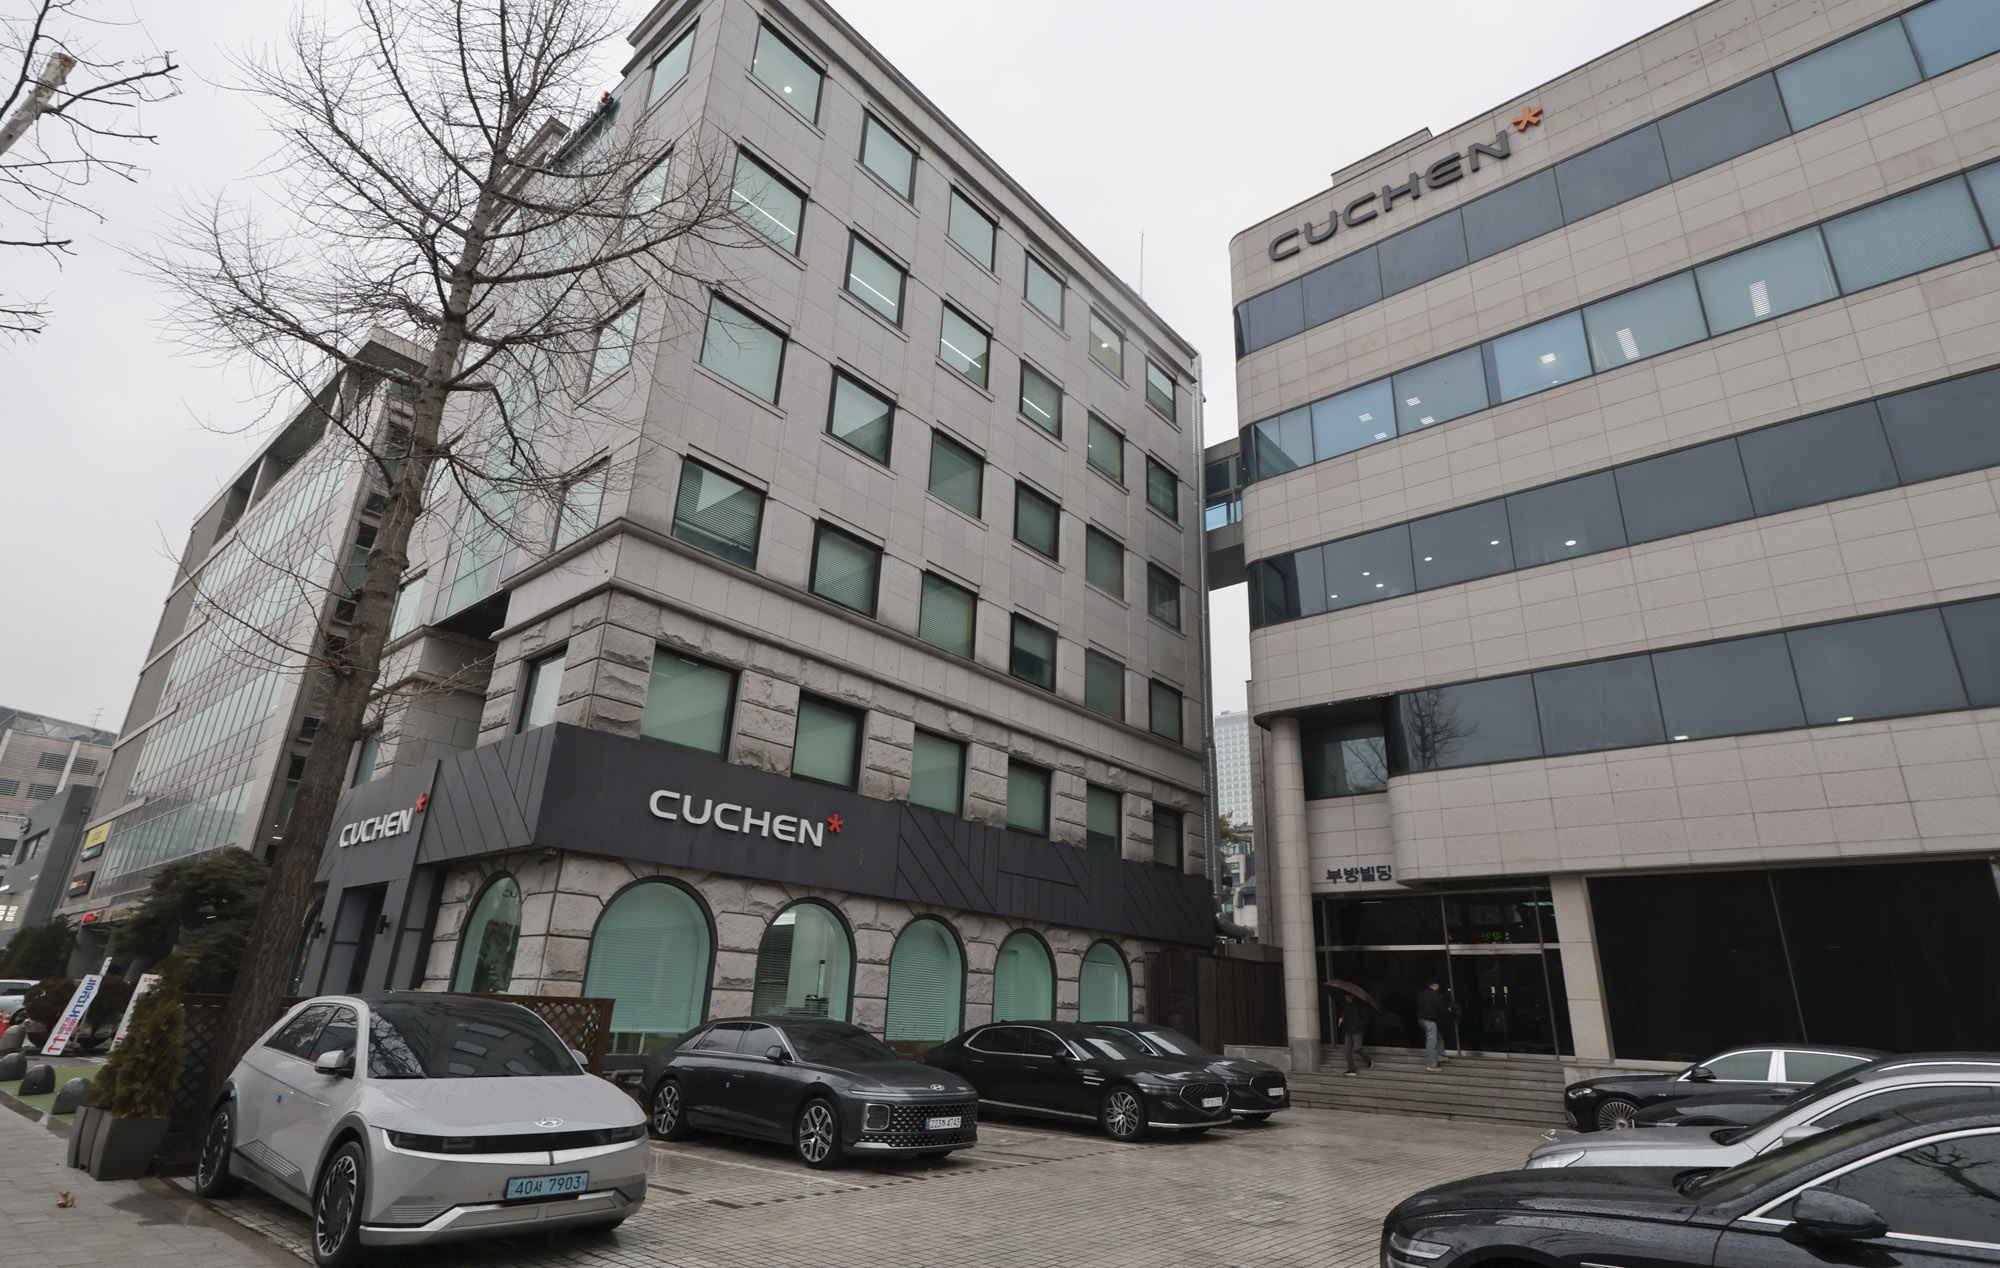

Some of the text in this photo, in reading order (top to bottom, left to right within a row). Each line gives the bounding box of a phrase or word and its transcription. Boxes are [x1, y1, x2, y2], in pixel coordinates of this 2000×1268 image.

[1268, 129, 1511, 261] CUCHEN
[339, 807, 415, 848] CUCHEN
[649, 789, 824, 847] CUCHEN
[1326, 865, 1392, 885] 부방빌딩
[515, 1176, 581, 1195] 40서 7903
